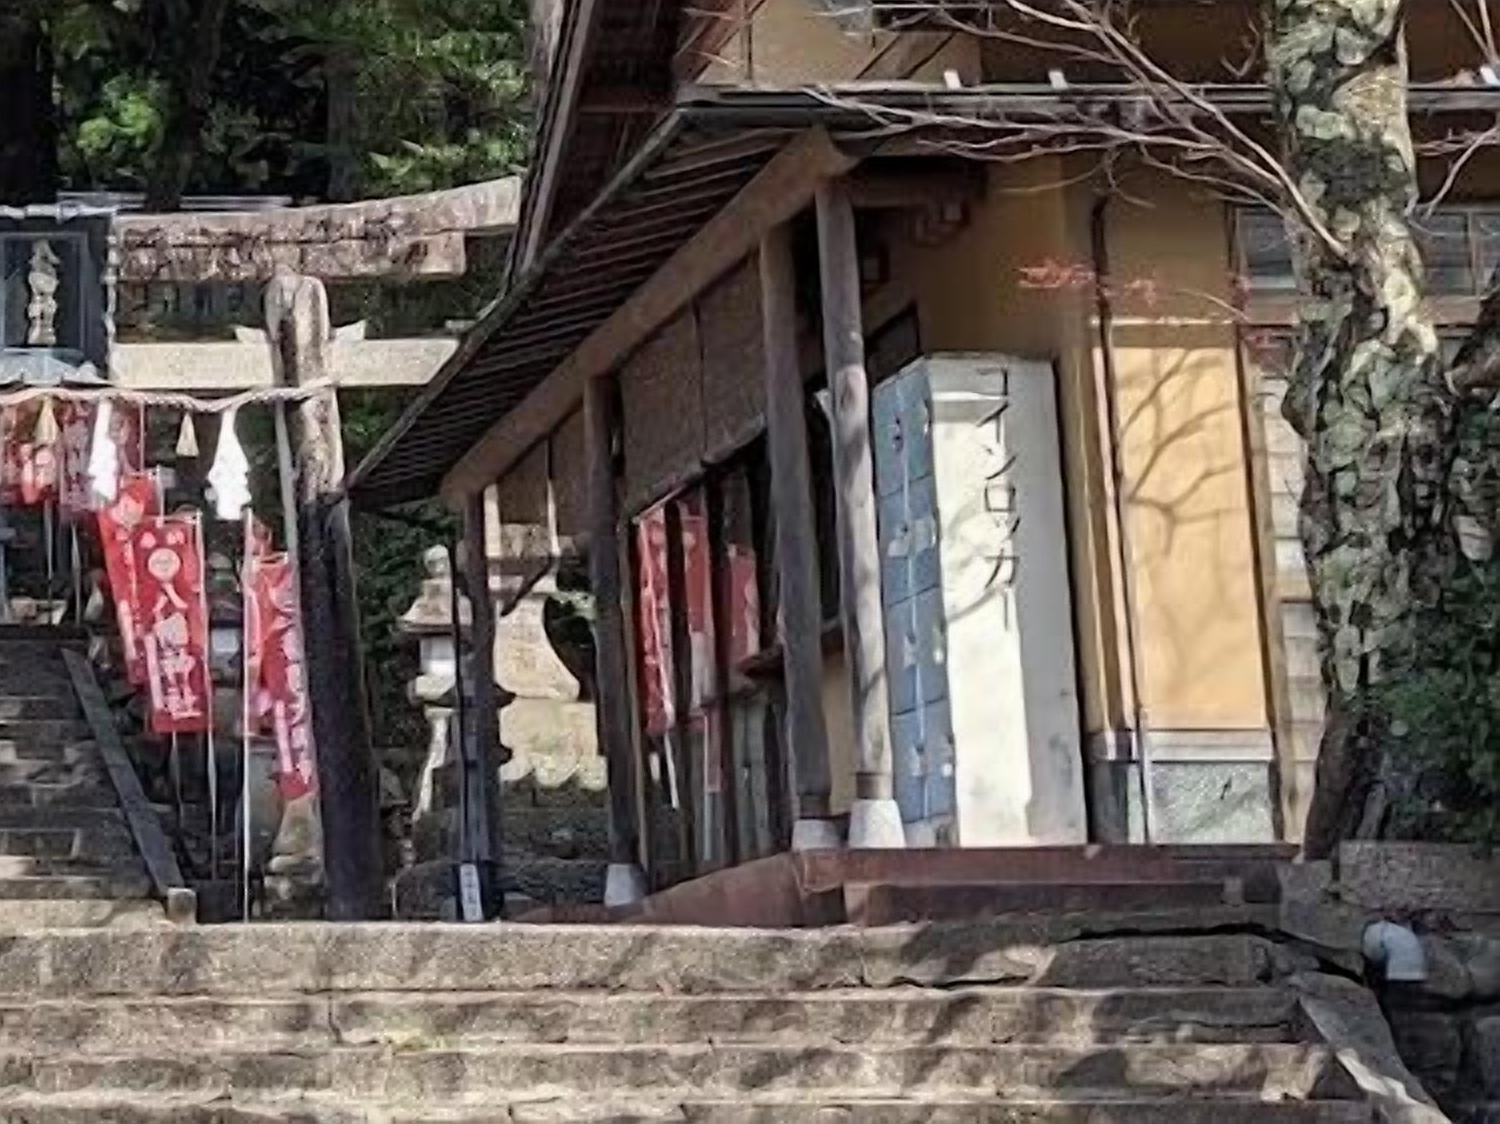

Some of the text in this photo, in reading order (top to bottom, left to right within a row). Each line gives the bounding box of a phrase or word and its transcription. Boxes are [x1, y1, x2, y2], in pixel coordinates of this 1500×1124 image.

[976, 367, 1020, 631] コインロッカー
